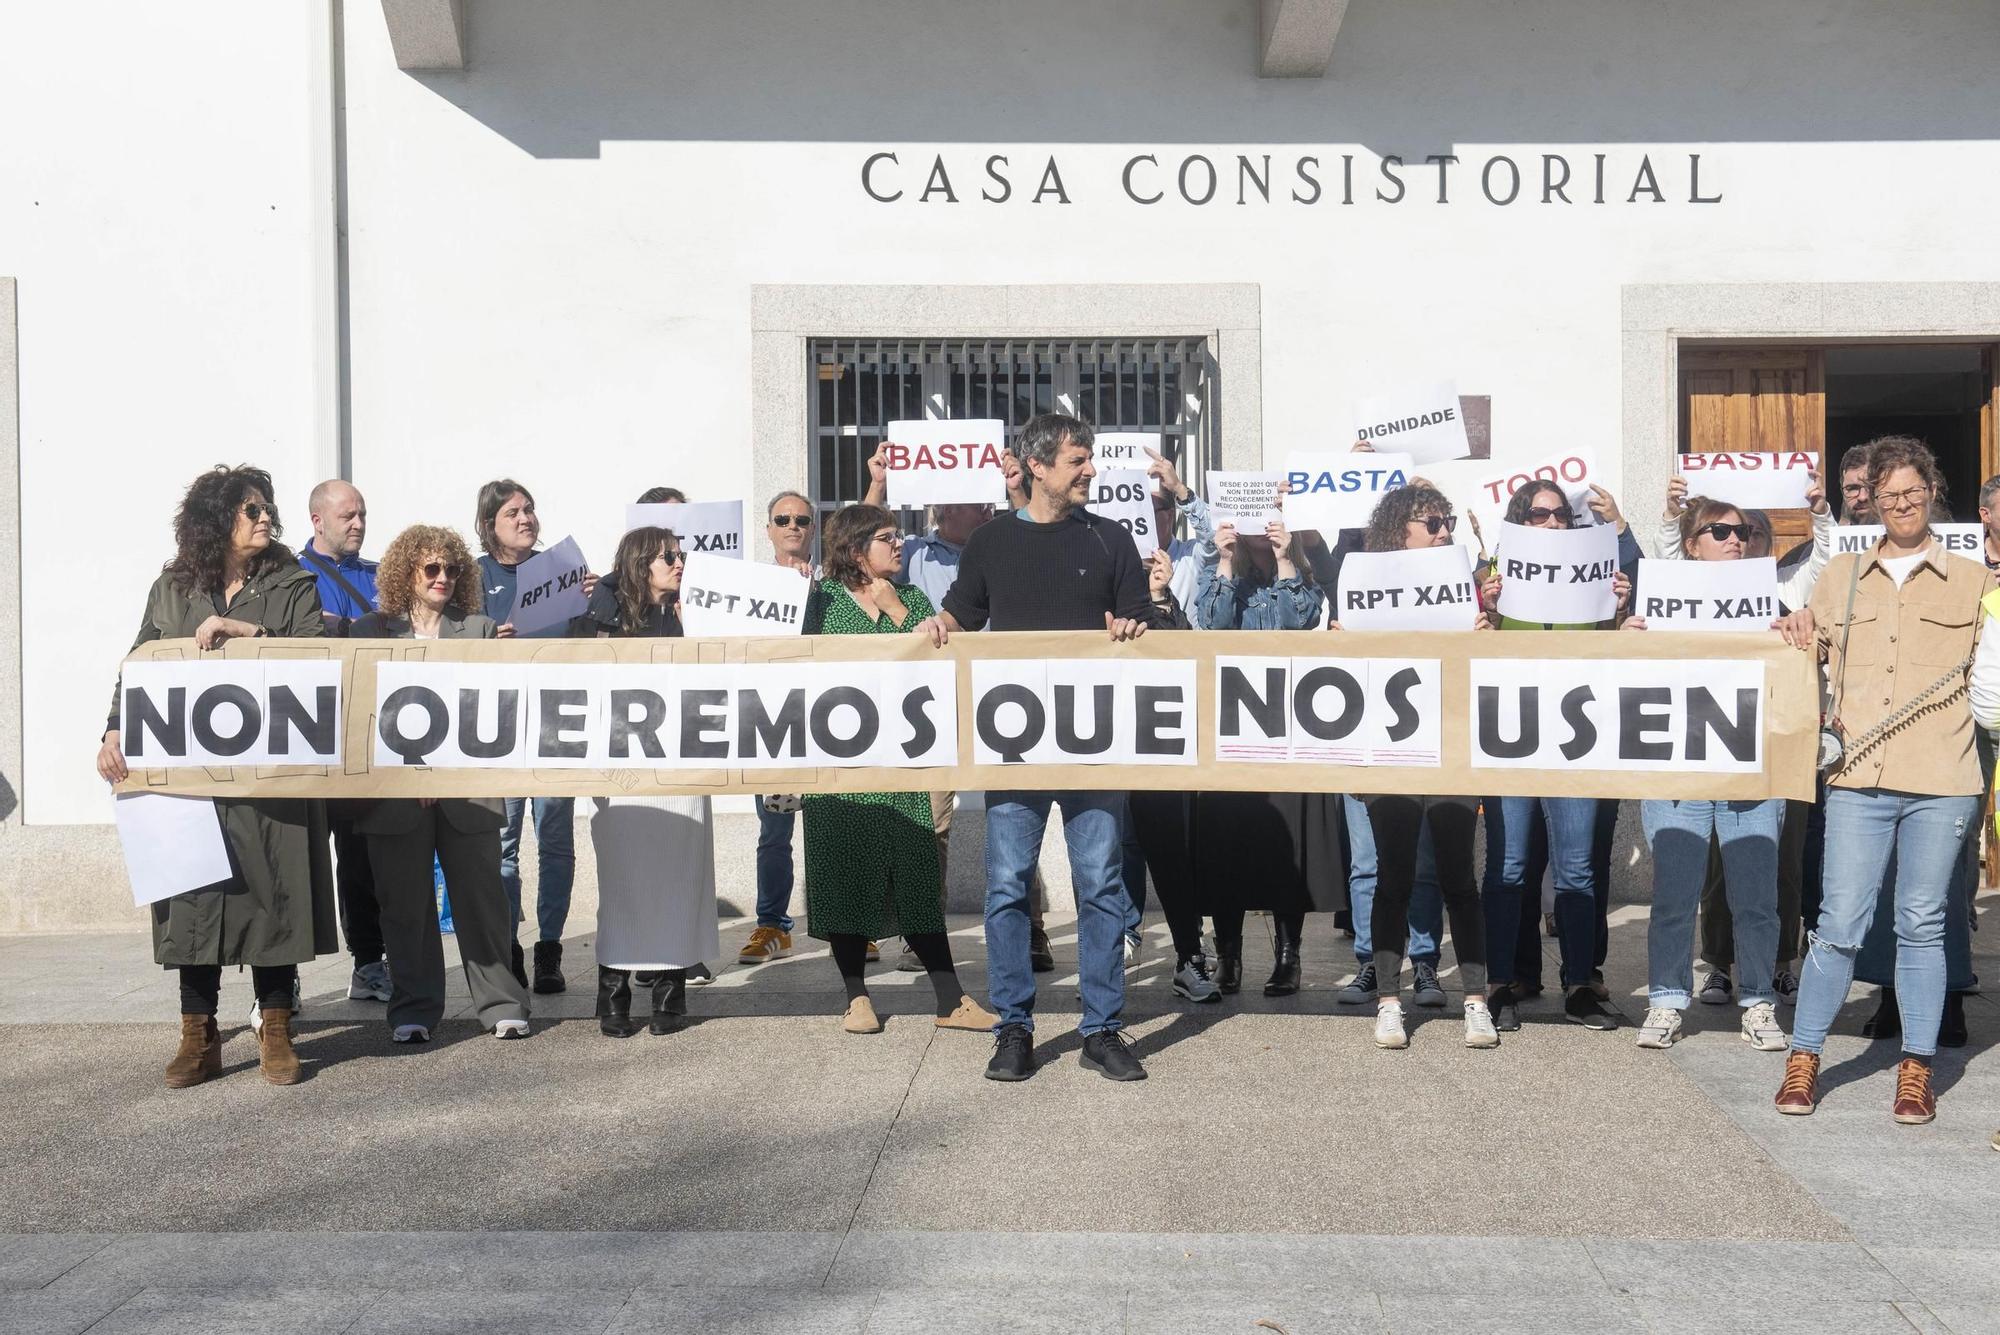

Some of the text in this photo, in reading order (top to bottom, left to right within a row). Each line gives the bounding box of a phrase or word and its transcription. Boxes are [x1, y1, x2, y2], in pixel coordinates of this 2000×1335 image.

[861, 152, 1723, 206] CASA CONSISTORIAL
[1358, 408, 1455, 441] DIGNIDADE
[889, 443, 1003, 471] BASTA
[1101, 445, 1137, 459] RPT
[1287, 469, 1408, 496] BASTA
[693, 532, 738, 551] XA!!
[1506, 558, 1615, 583] RPT XA!!
[520, 580, 552, 608] RPT
[686, 586, 798, 624] RPT XA!!
[1347, 583, 1472, 610] RPT XA!!
[1646, 596, 1772, 619] RPT XA!!
[125, 666, 1759, 766] NON QUEREMOS QUE NOS USEN
